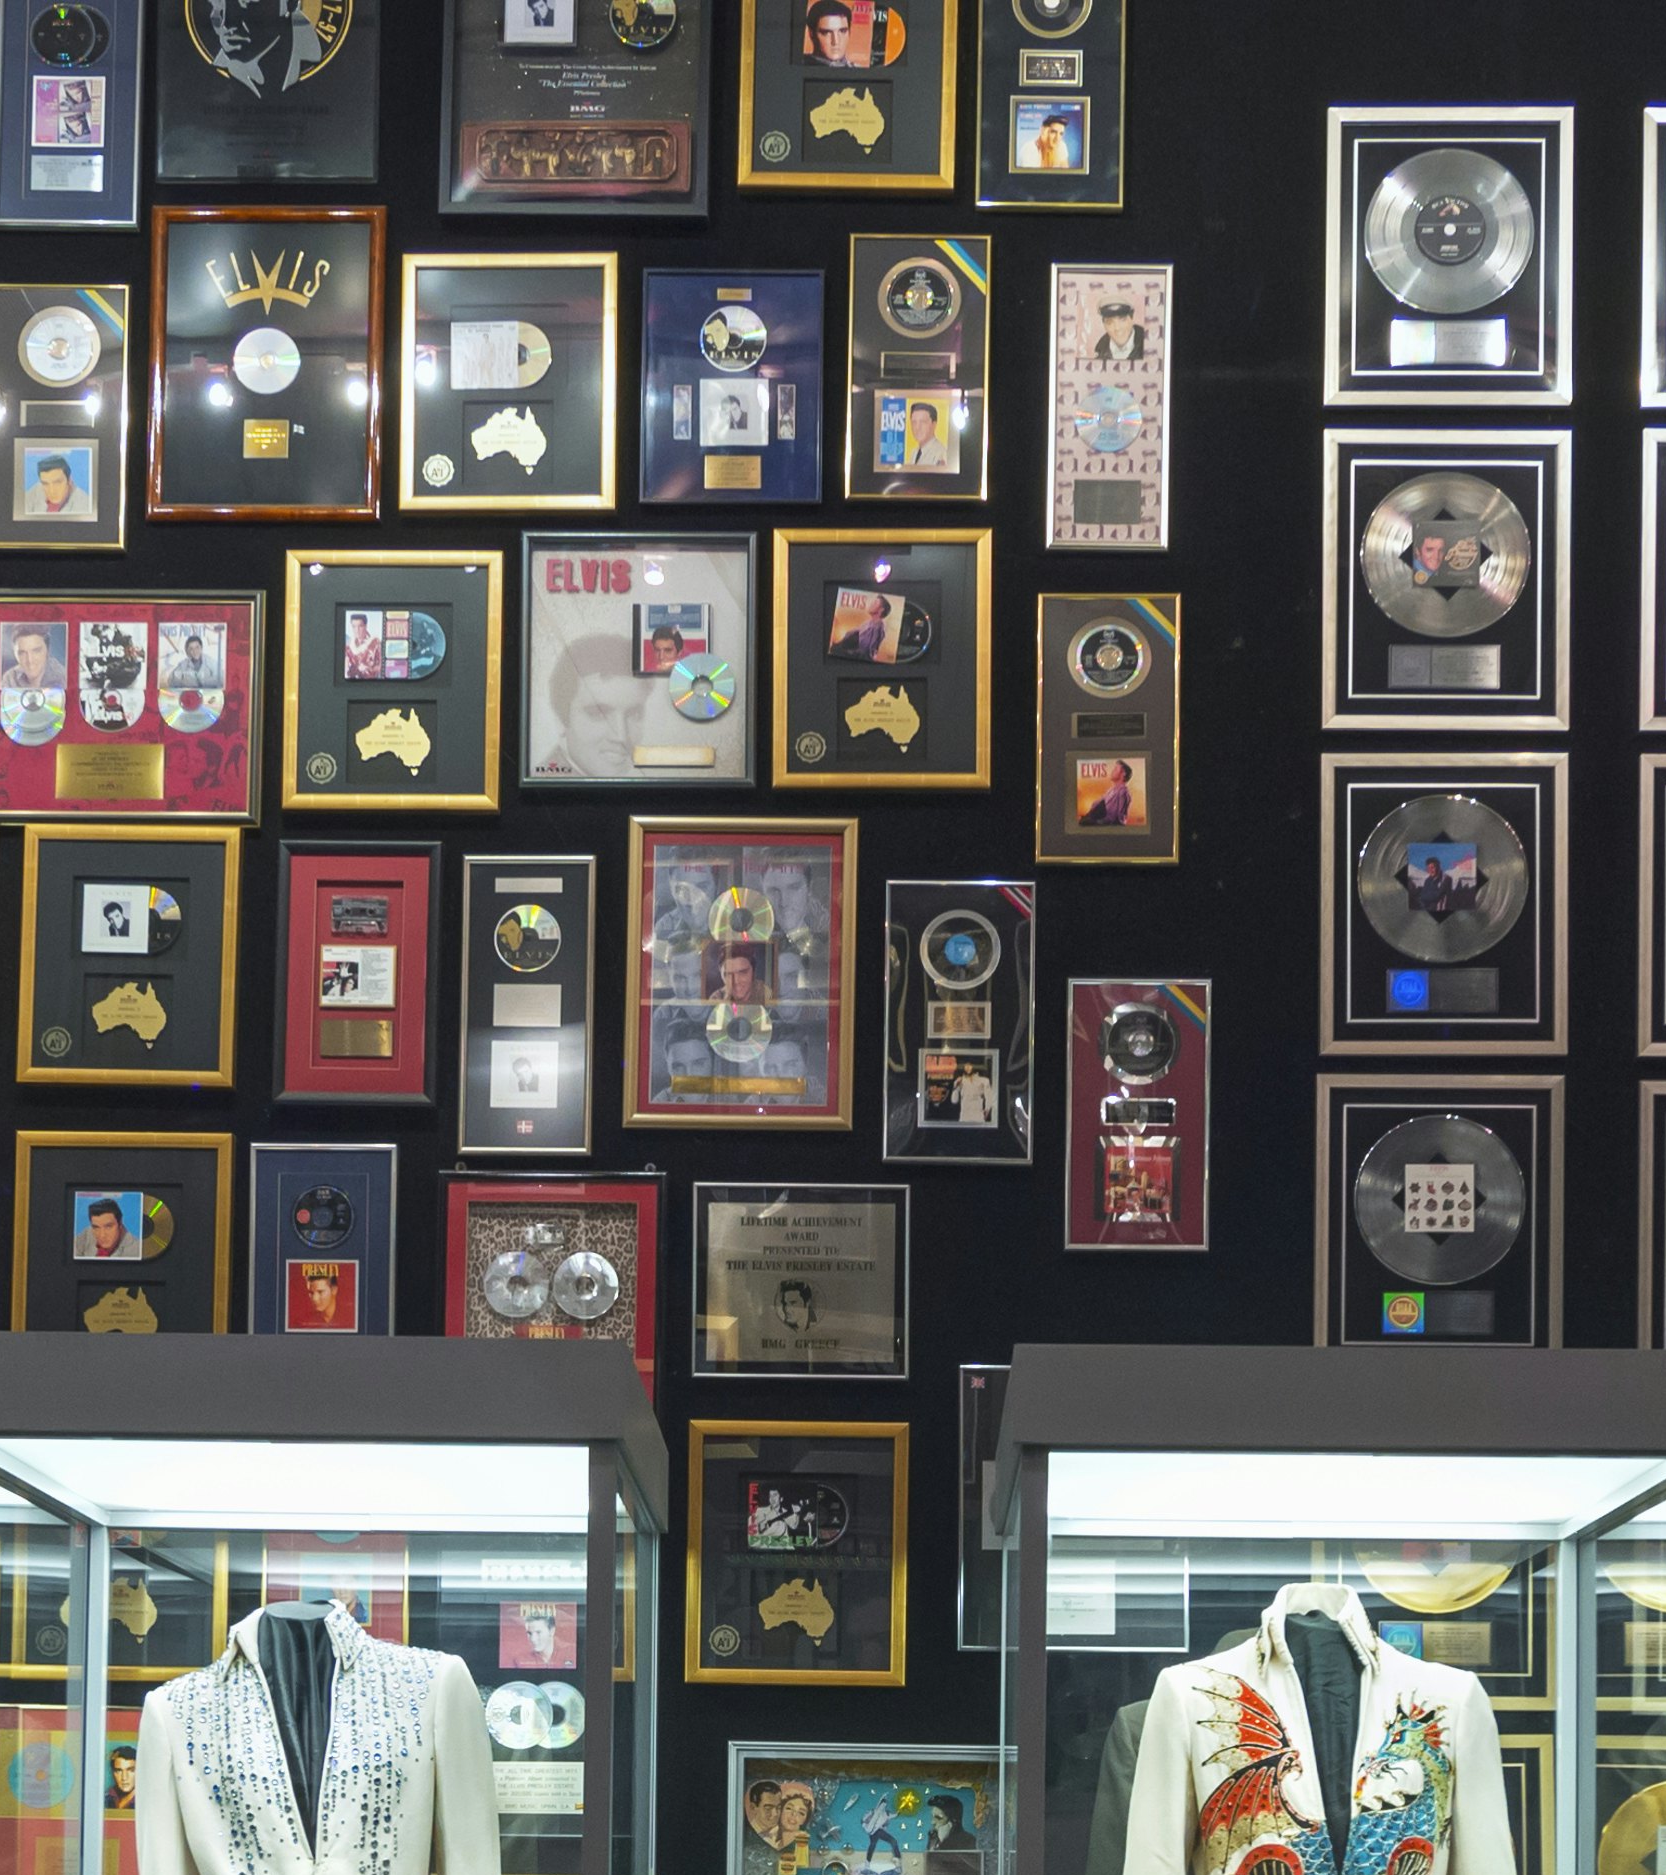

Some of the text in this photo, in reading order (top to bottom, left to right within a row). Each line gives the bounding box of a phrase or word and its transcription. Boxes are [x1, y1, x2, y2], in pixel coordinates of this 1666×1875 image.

[205, 248, 331, 314] ELVIS
[882, 410, 905, 431] ELVIS
[545, 559, 631, 593] ELVIS
[840, 589, 867, 611] ELVIS
[534, 763, 573, 774] BMG
[1080, 762, 1108, 779] ELVIS
[741, 1217, 862, 1227] LIFETIME ACHIEVEMENT
[785, 1232, 819, 1241] AWARD
[763, 1246, 820, 1256] PRESENTED
[301, 1264, 339, 1277] PRESLEY
[726, 1261, 876, 1271] THE ELVIS PRESLEY ESTATE
[762, 1339, 841, 1349] BMG GREECE
